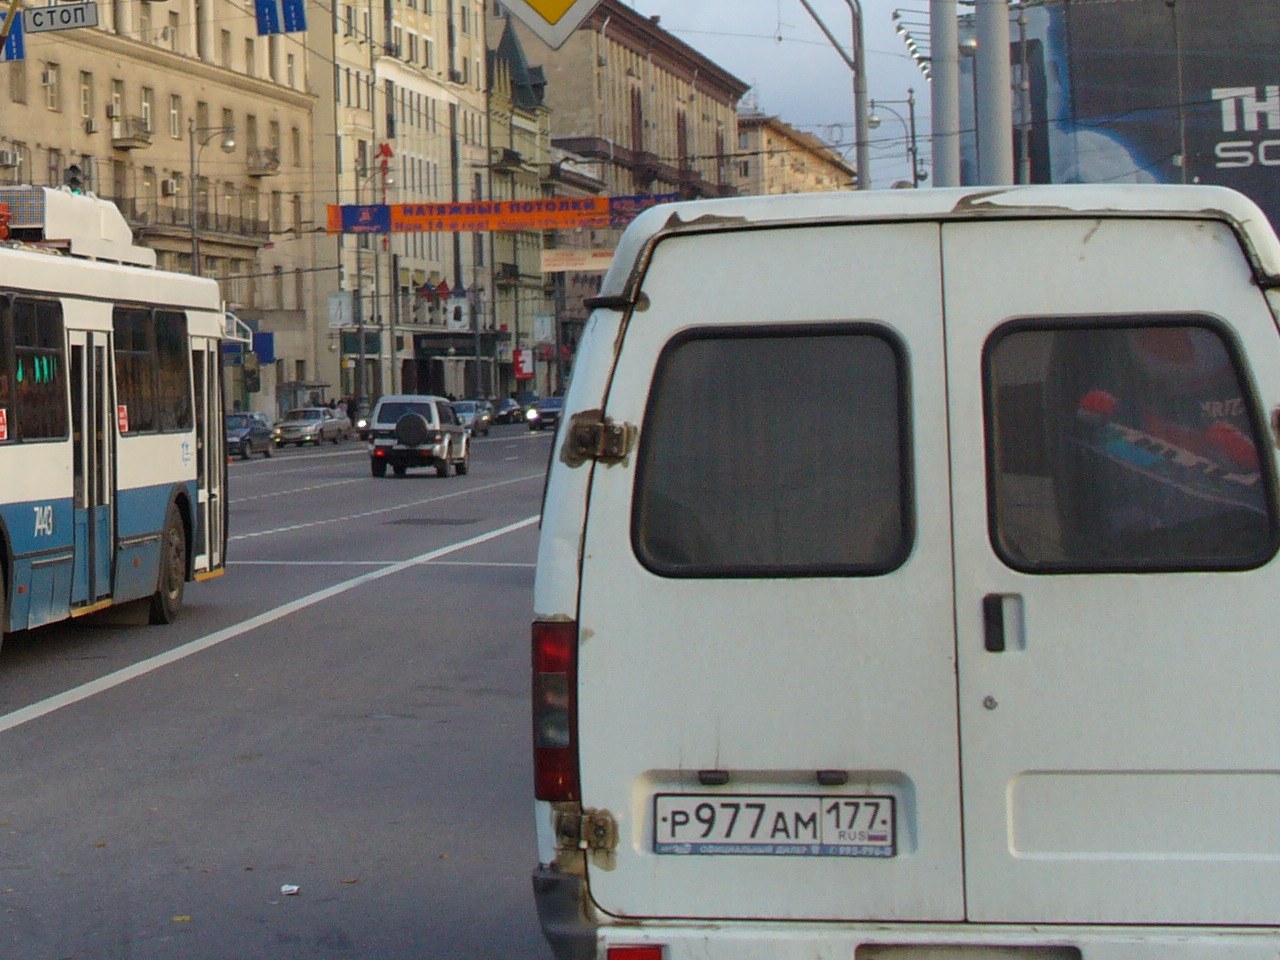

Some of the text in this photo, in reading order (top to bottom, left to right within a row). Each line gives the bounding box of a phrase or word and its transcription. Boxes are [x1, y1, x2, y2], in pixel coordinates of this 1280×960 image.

[33, 8, 87, 27] СТОП
[1211, 85, 1280, 132] TH
[825, 801, 881, 830] 177
[838, 830, 866, 841] RUS
